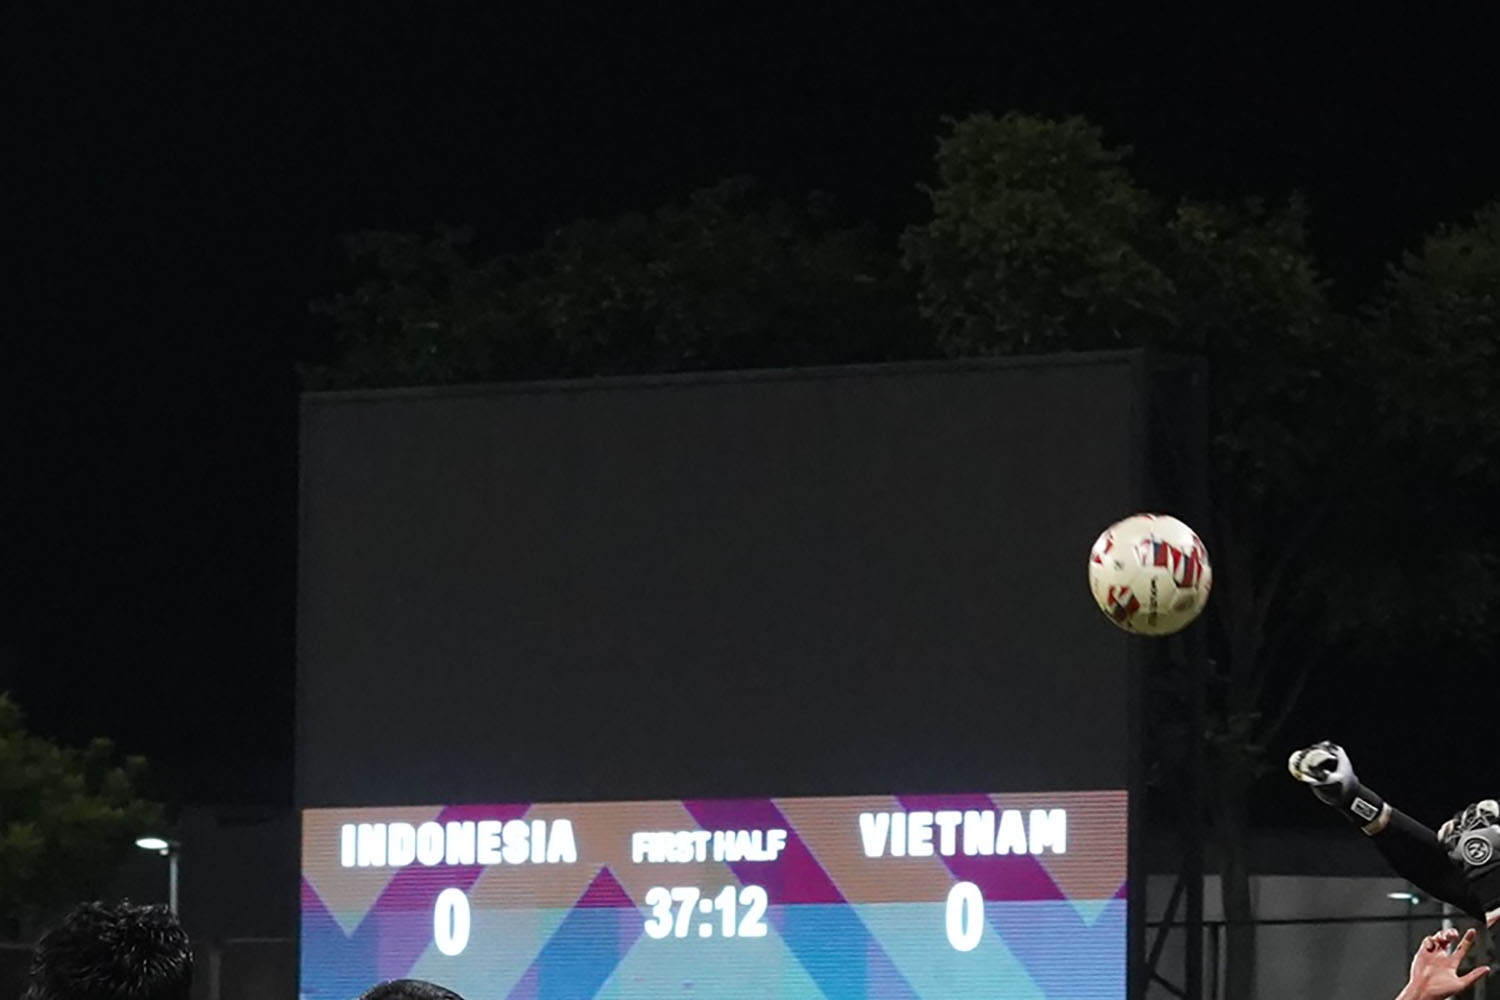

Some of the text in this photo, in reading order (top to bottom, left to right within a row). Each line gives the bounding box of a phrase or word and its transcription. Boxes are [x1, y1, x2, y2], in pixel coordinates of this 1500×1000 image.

[341, 819, 577, 867] INDONESIA
[632, 829, 787, 863] FIRST HALF
[859, 809, 1067, 857] VIETNAM
[433, 888, 471, 956] 0
[644, 885, 768, 939] 37:12
[945, 881, 984, 952] 0
